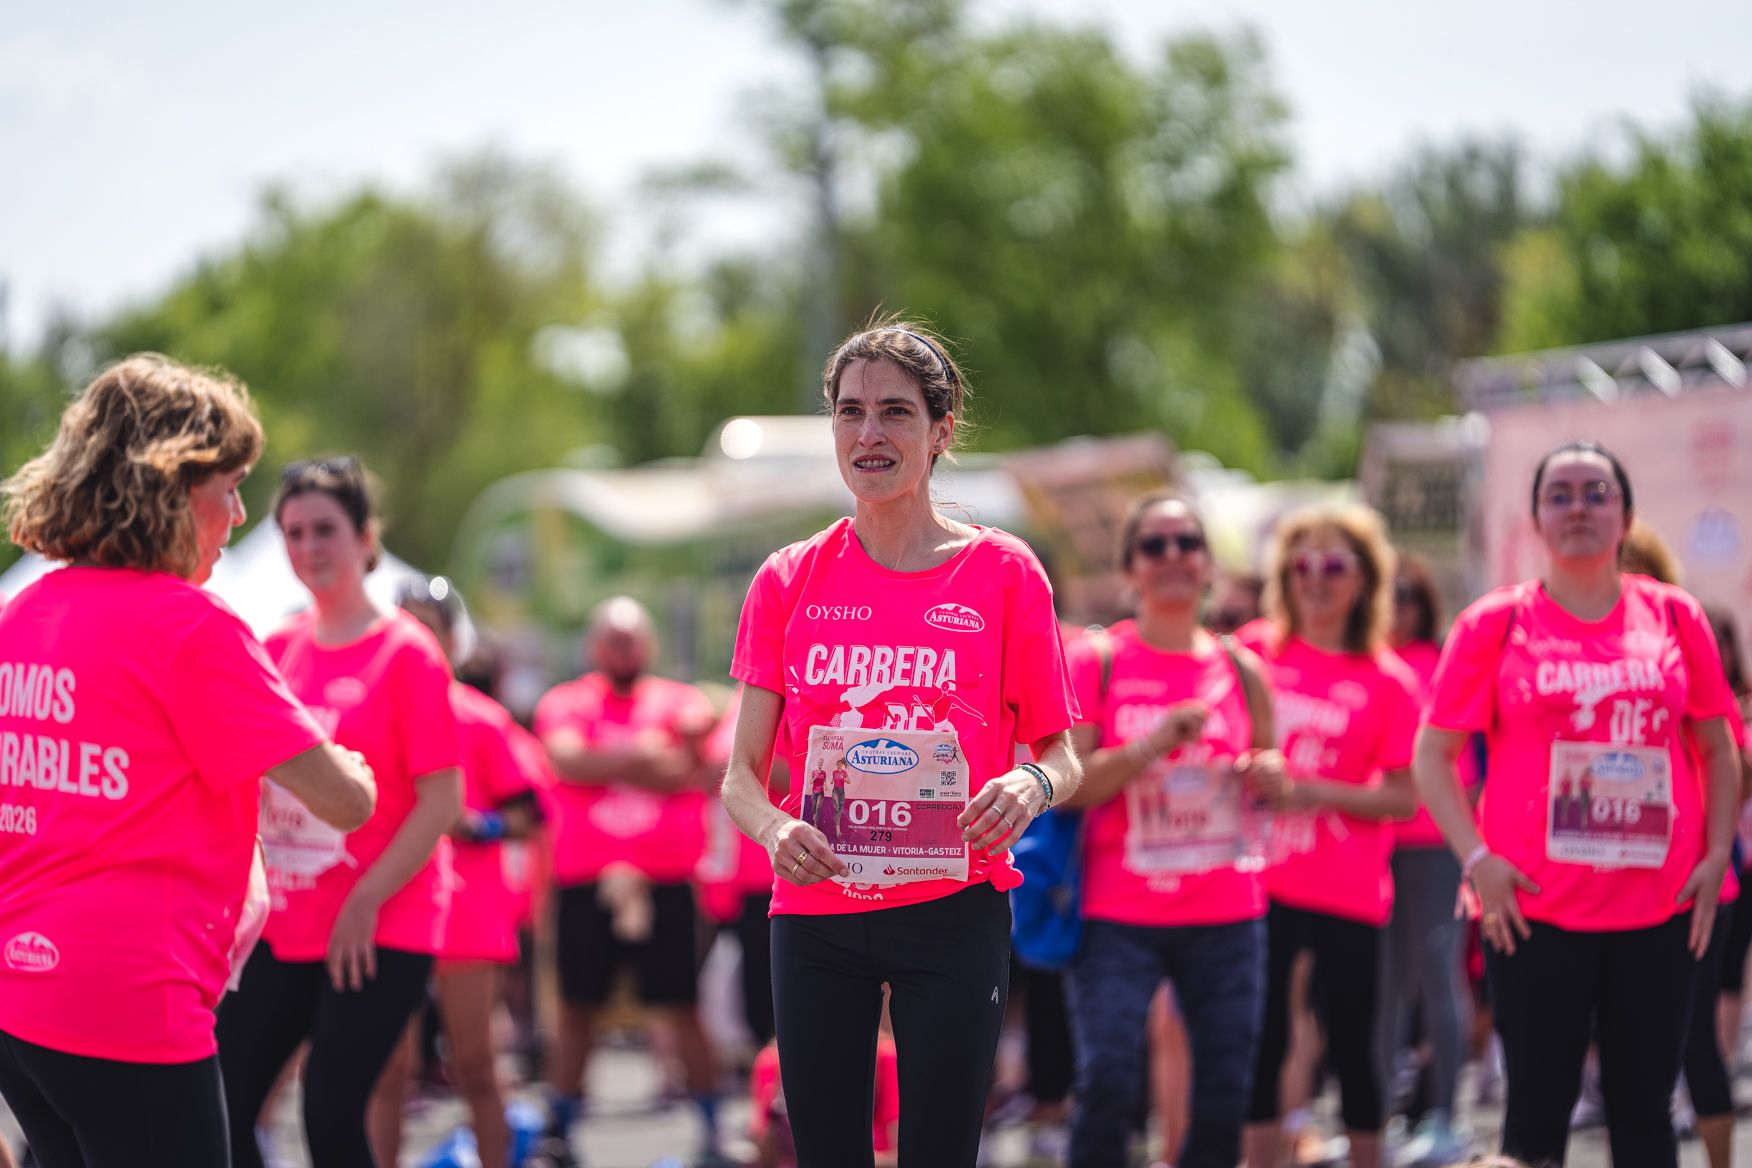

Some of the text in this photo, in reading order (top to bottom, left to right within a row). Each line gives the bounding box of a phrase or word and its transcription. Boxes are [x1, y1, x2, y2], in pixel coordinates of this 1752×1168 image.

[806, 604, 872, 620] OYSHO
[929, 611, 979, 629] ASTURIANA
[805, 643, 957, 691] CARRERA
[0, 662, 76, 724] OMOS
[0, 731, 130, 800] RABLES
[851, 749, 914, 766] ASTURIANA
[849, 799, 912, 827] 016
[1592, 798, 1641, 824] 016
[870, 830, 893, 842] 279
[836, 843, 847, 852] DE
[848, 844, 858, 853] LA
[860, 845, 887, 854] MUJER
[892, 846, 962, 856] VITORIA-GASTEIZ
[897, 866, 949, 876] Santander
